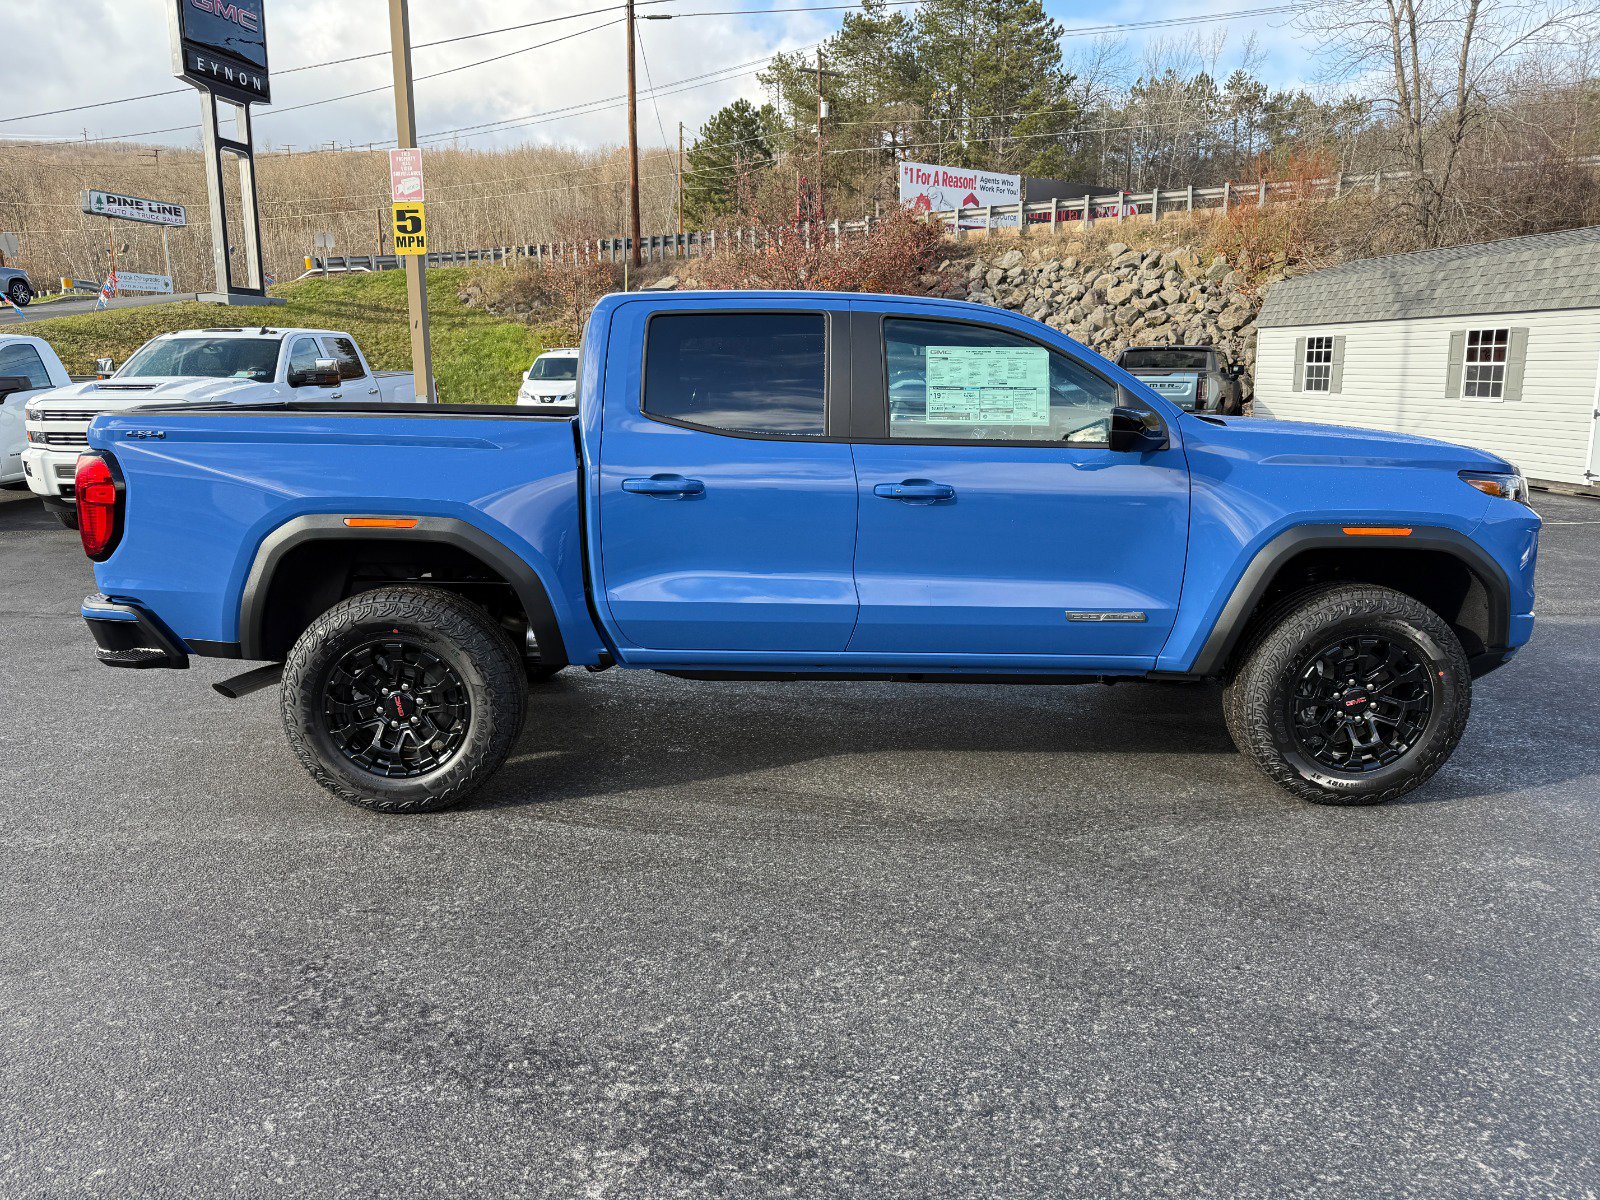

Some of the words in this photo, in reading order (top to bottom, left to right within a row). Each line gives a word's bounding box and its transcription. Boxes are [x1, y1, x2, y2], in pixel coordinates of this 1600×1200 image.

[192, 0, 257, 33] GMC
[196, 56, 261, 91] EYNON
[904, 166, 914, 184] #1
[916, 169, 931, 186] For
[932, 170, 940, 187] A
[942, 171, 977, 191] Reason!
[980, 176, 1000, 185] Agents
[1001, 178, 1014, 186] Who
[980, 185, 995, 193] Work
[996, 186, 1006, 194] For
[106, 195, 144, 211] PINE
[148, 202, 182, 217] LINE
[107, 207, 127, 216] AUTO
[137, 211, 160, 220] TRUCK
[162, 216, 184, 224] SALES
[396, 209, 422, 235] 5
[396, 236, 425, 248] MPH
[1345, 697, 1367, 707] GMC
